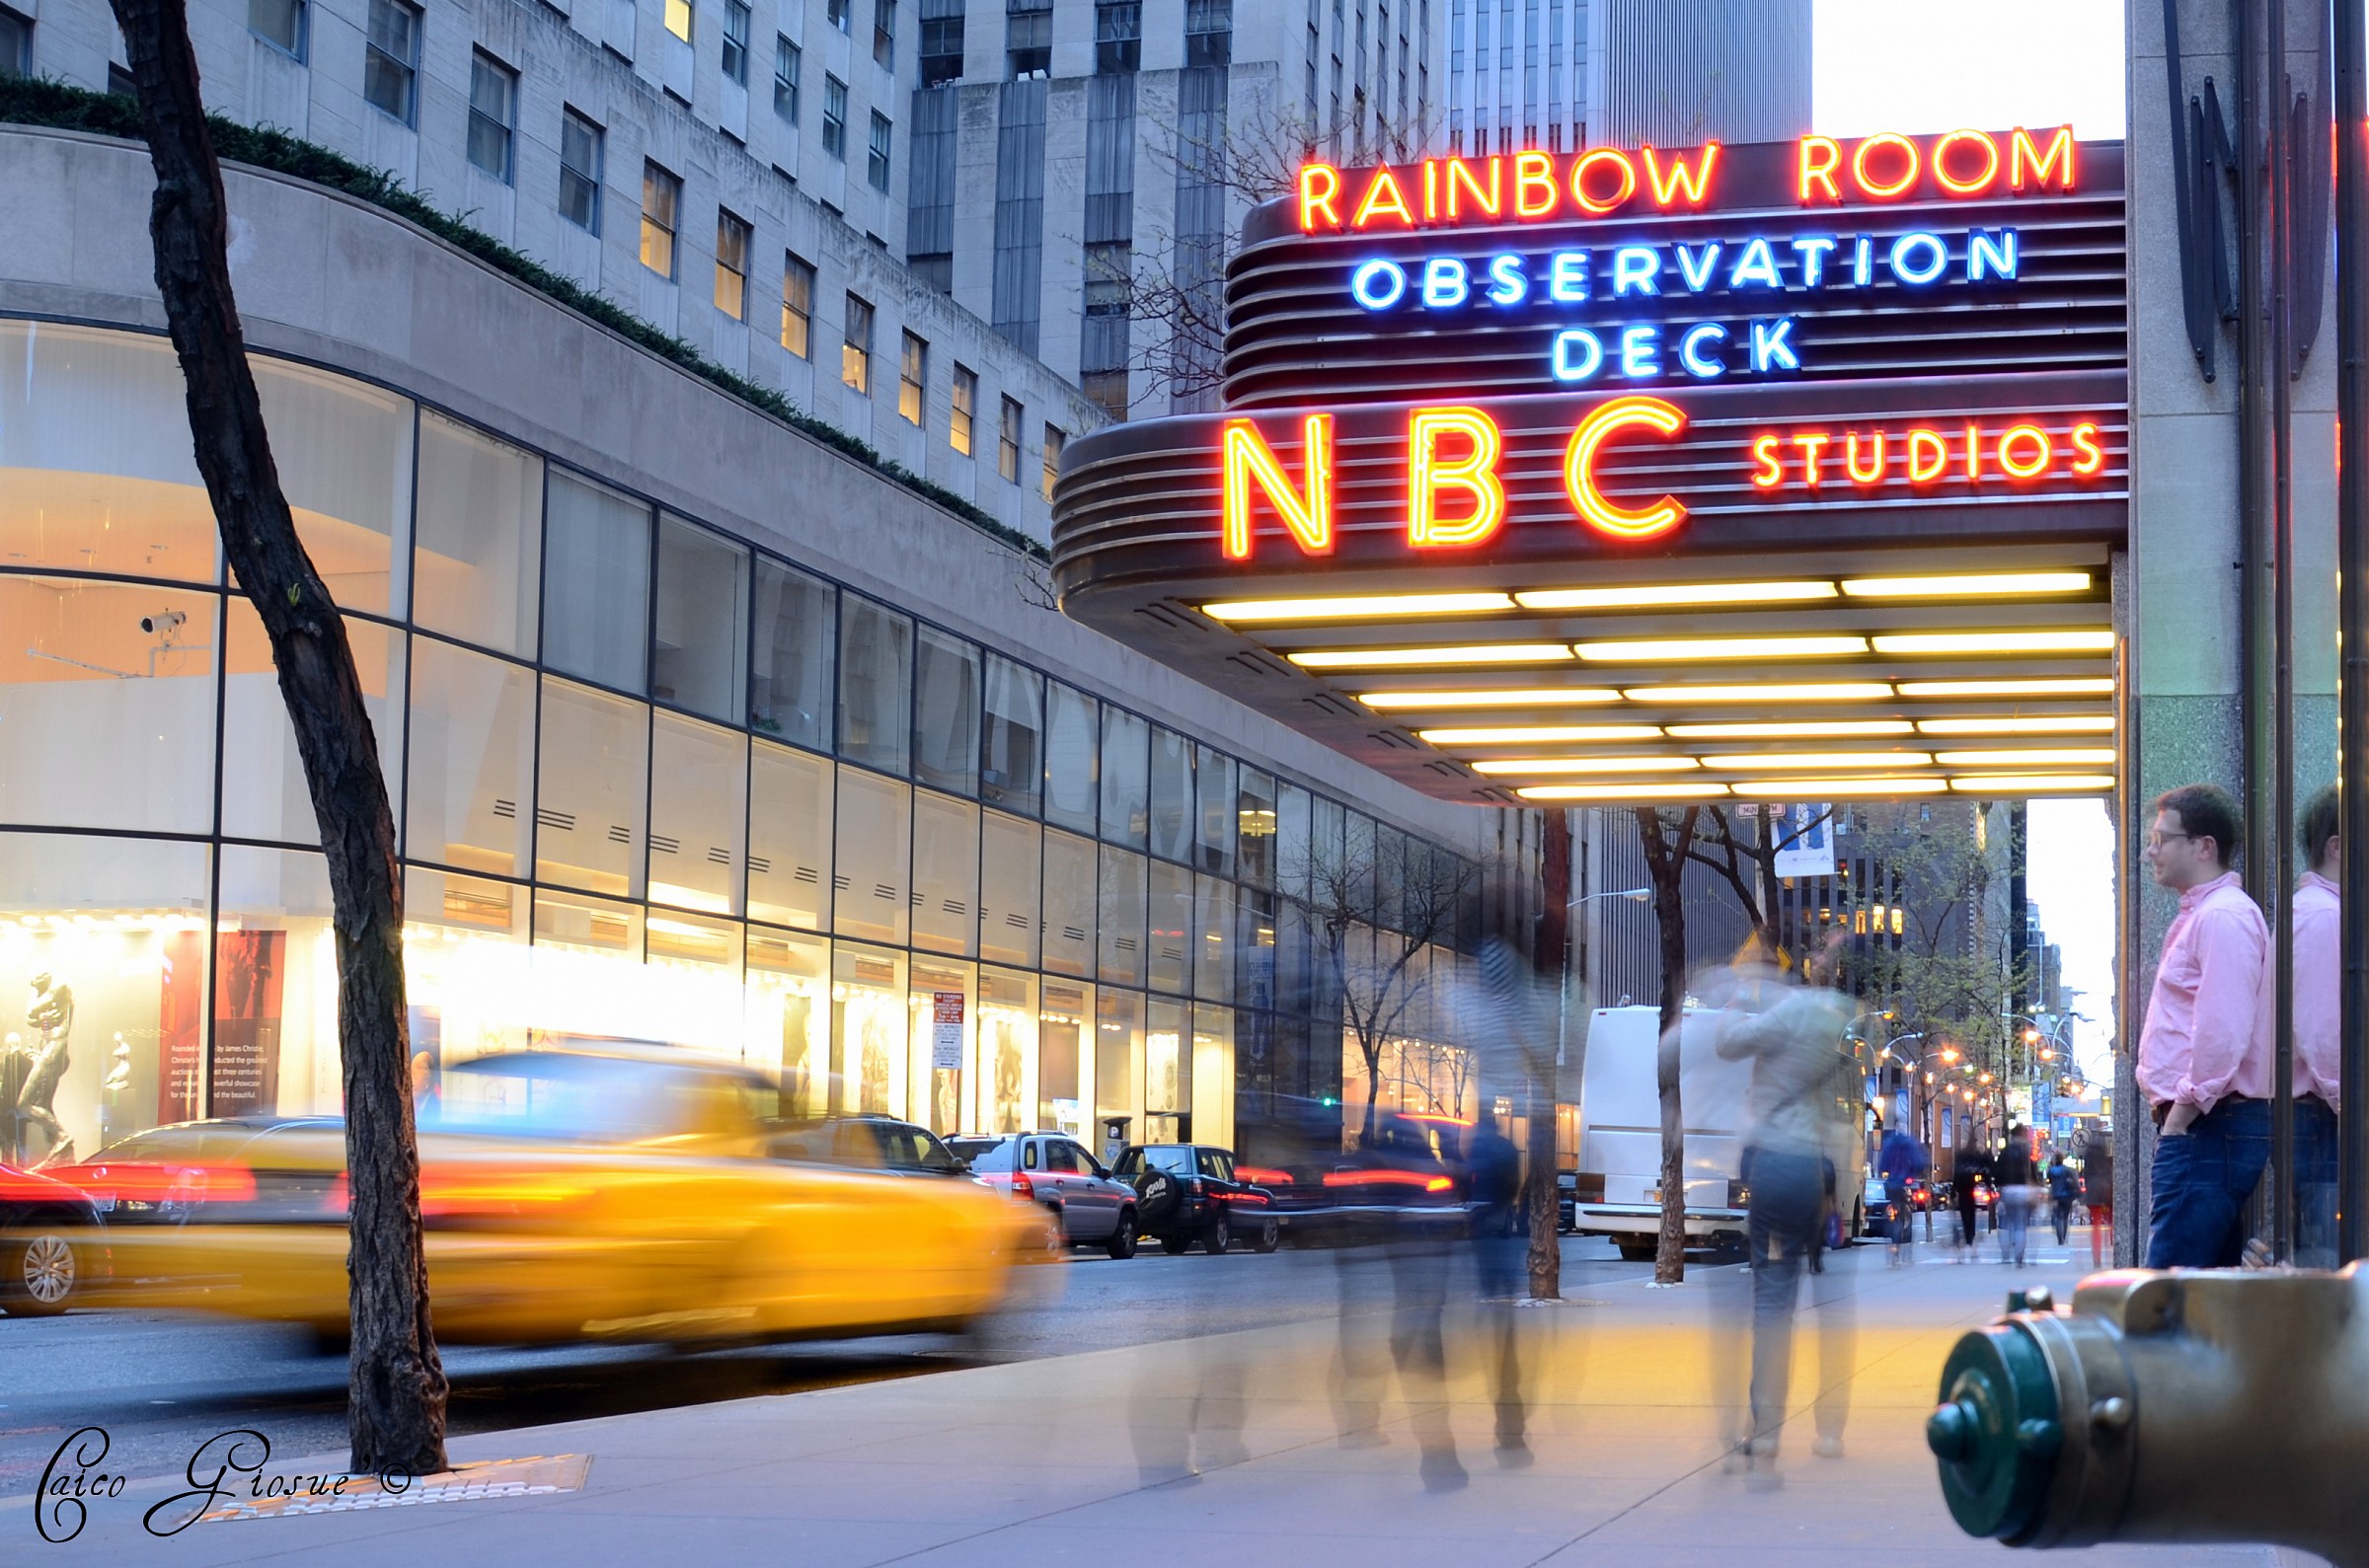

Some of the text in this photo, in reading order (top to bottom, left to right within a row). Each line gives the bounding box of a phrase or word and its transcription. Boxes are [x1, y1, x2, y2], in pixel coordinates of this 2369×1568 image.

[1300, 124, 2074, 234] RAINBOW ROOM
[1352, 228, 2018, 310] OBSERVATION
[1553, 318, 1800, 381] DECK
[1753, 422, 2101, 487] STUDIOS
